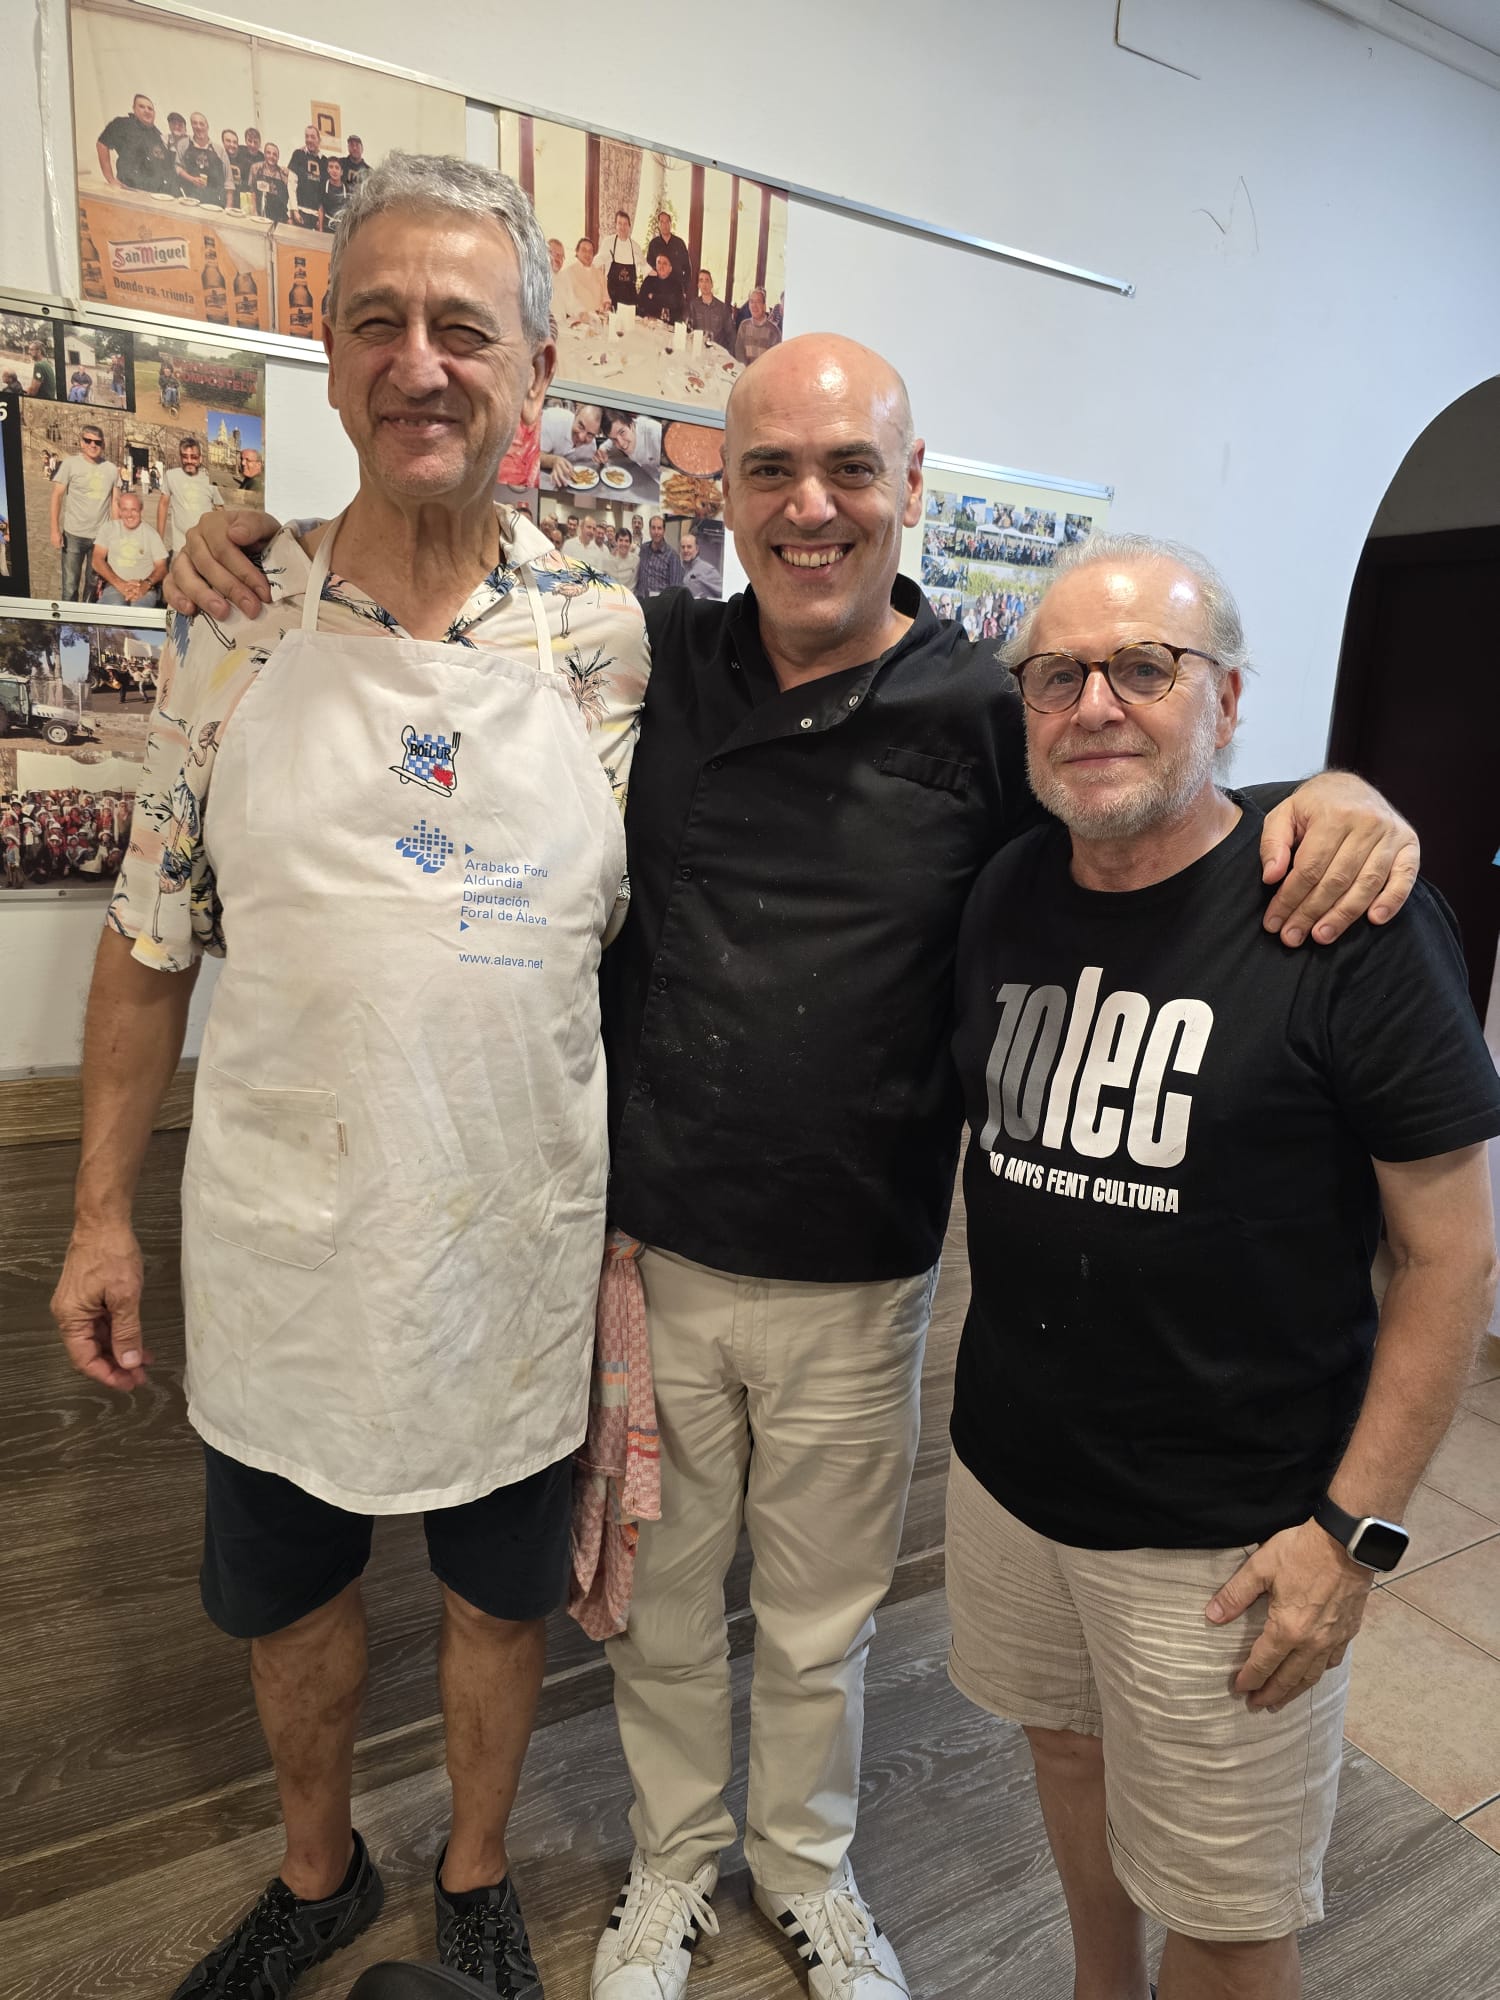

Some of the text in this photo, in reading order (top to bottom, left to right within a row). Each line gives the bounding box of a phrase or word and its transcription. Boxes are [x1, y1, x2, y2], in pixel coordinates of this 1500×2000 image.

[113, 277, 143, 292] Donde
[465, 858, 549, 878] Arabako Foru
[463, 874, 523, 889] Aldundia
[463, 890, 530, 908] Diputación
[460, 905, 547, 926] Foral de Álava
[459, 953, 544, 970] www.alava.net
[989, 1151, 1179, 1214] 10 ANYS FENT CULTURA
